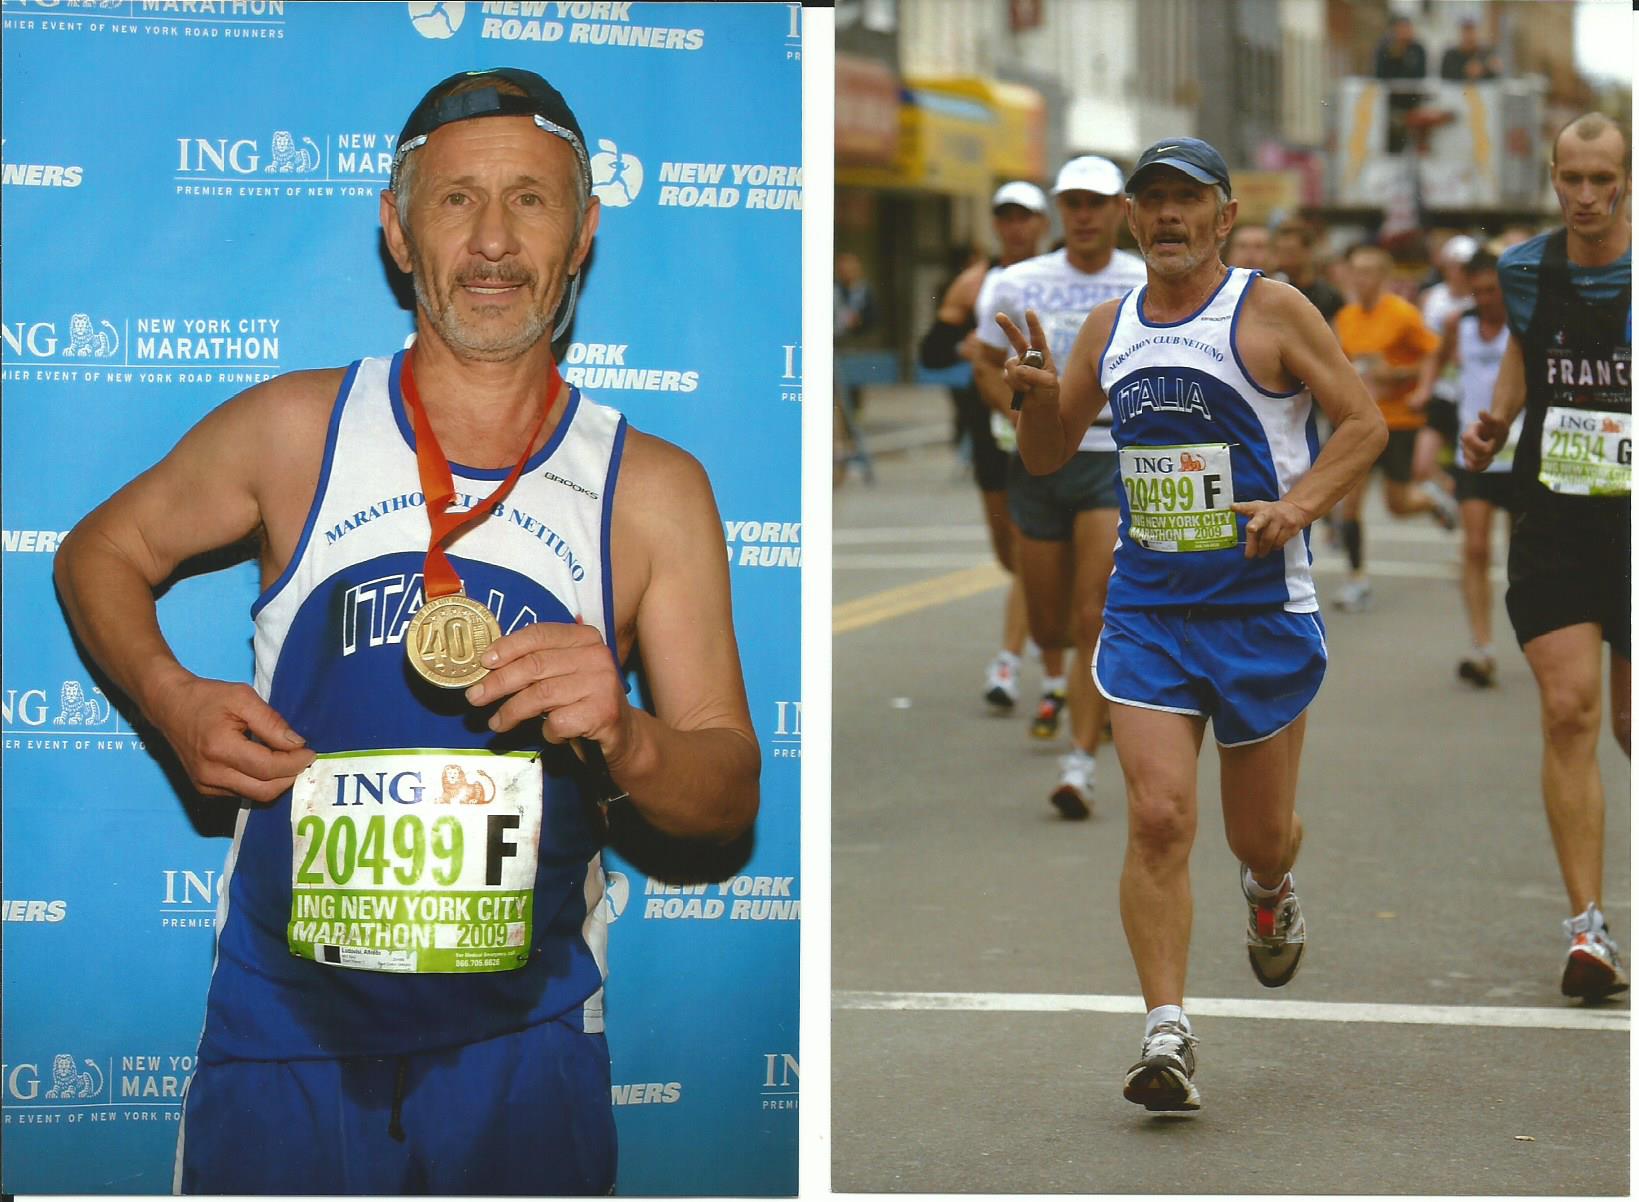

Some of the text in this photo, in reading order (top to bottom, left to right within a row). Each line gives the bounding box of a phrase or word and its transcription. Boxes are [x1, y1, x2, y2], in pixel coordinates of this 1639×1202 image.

[481, 2, 633, 21] NEW YORK
[42, 21, 82, 31] EVENT
[90, 23, 105, 32] OF
[112, 25, 138, 33] NEW
[145, 26, 178, 36] YORK
[185, 27, 219, 38] ROAD
[225, 28, 285, 39] RUNNERS
[481, 18, 705, 50] ROAD RUNNERS
[338, 133, 376, 149] NEW
[177, 138, 260, 173] ING
[2, 163, 84, 188] NERS
[658, 162, 802, 187] NEW YORK
[176, 186, 373, 197] PREMIER EVENT OF NEW YORK
[658, 185, 740, 208] ROAD
[138, 319, 280, 335] NEW YORK CITY
[137, 338, 279, 360] MARATHON
[1153, 335, 1181, 345] CLUB
[1182, 336, 1225, 363] NETTUNO
[37, 371, 77, 381] EVENT
[85, 372, 100, 382] OF
[107, 373, 132, 383] NEW
[139, 373, 173, 383] YORK
[179, 374, 212, 383] ROAD
[566, 366, 700, 393] RUNNERS
[1546, 358, 1632, 386] FRANC
[1116, 376, 1212, 424] ITALIA
[1560, 414, 1597, 432] ING
[1547, 429, 1608, 463] 21514
[1134, 456, 1174, 474] ING
[544, 471, 600, 501] BROOKS
[1124, 474, 1221, 512] 20499 F
[1146, 516, 1167, 528] NEW
[1168, 515, 1201, 528] YORK
[1203, 512, 1232, 526] CITY
[325, 491, 425, 547] MARATHO
[507, 507, 586, 582] NETTUNO
[725, 521, 801, 544] YORK
[1130, 526, 1222, 541] MARATHON 2009
[738, 545, 802, 568] RUN
[420, 615, 476, 665] 40
[28, 740, 67, 750] EVENT
[75, 740, 90, 750] OF
[98, 740, 123, 750] NEW
[331, 770, 427, 807] ING
[296, 813, 521, 887] 20499 F
[162, 870, 224, 904] IN
[718, 875, 795, 897] YORK
[2, 900, 67, 922] ERS
[296, 894, 528, 921] ING NEW YORK CITY
[643, 898, 725, 920] ROAD
[292, 921, 509, 949] MARATHON 2009
[122, 1056, 198, 1071] NEW YO
[19, 1113, 60, 1124] EVENT
[68, 1113, 84, 1123] OF
[91, 1112, 117, 1122] NEW
[124, 1111, 158, 1121] YORK
